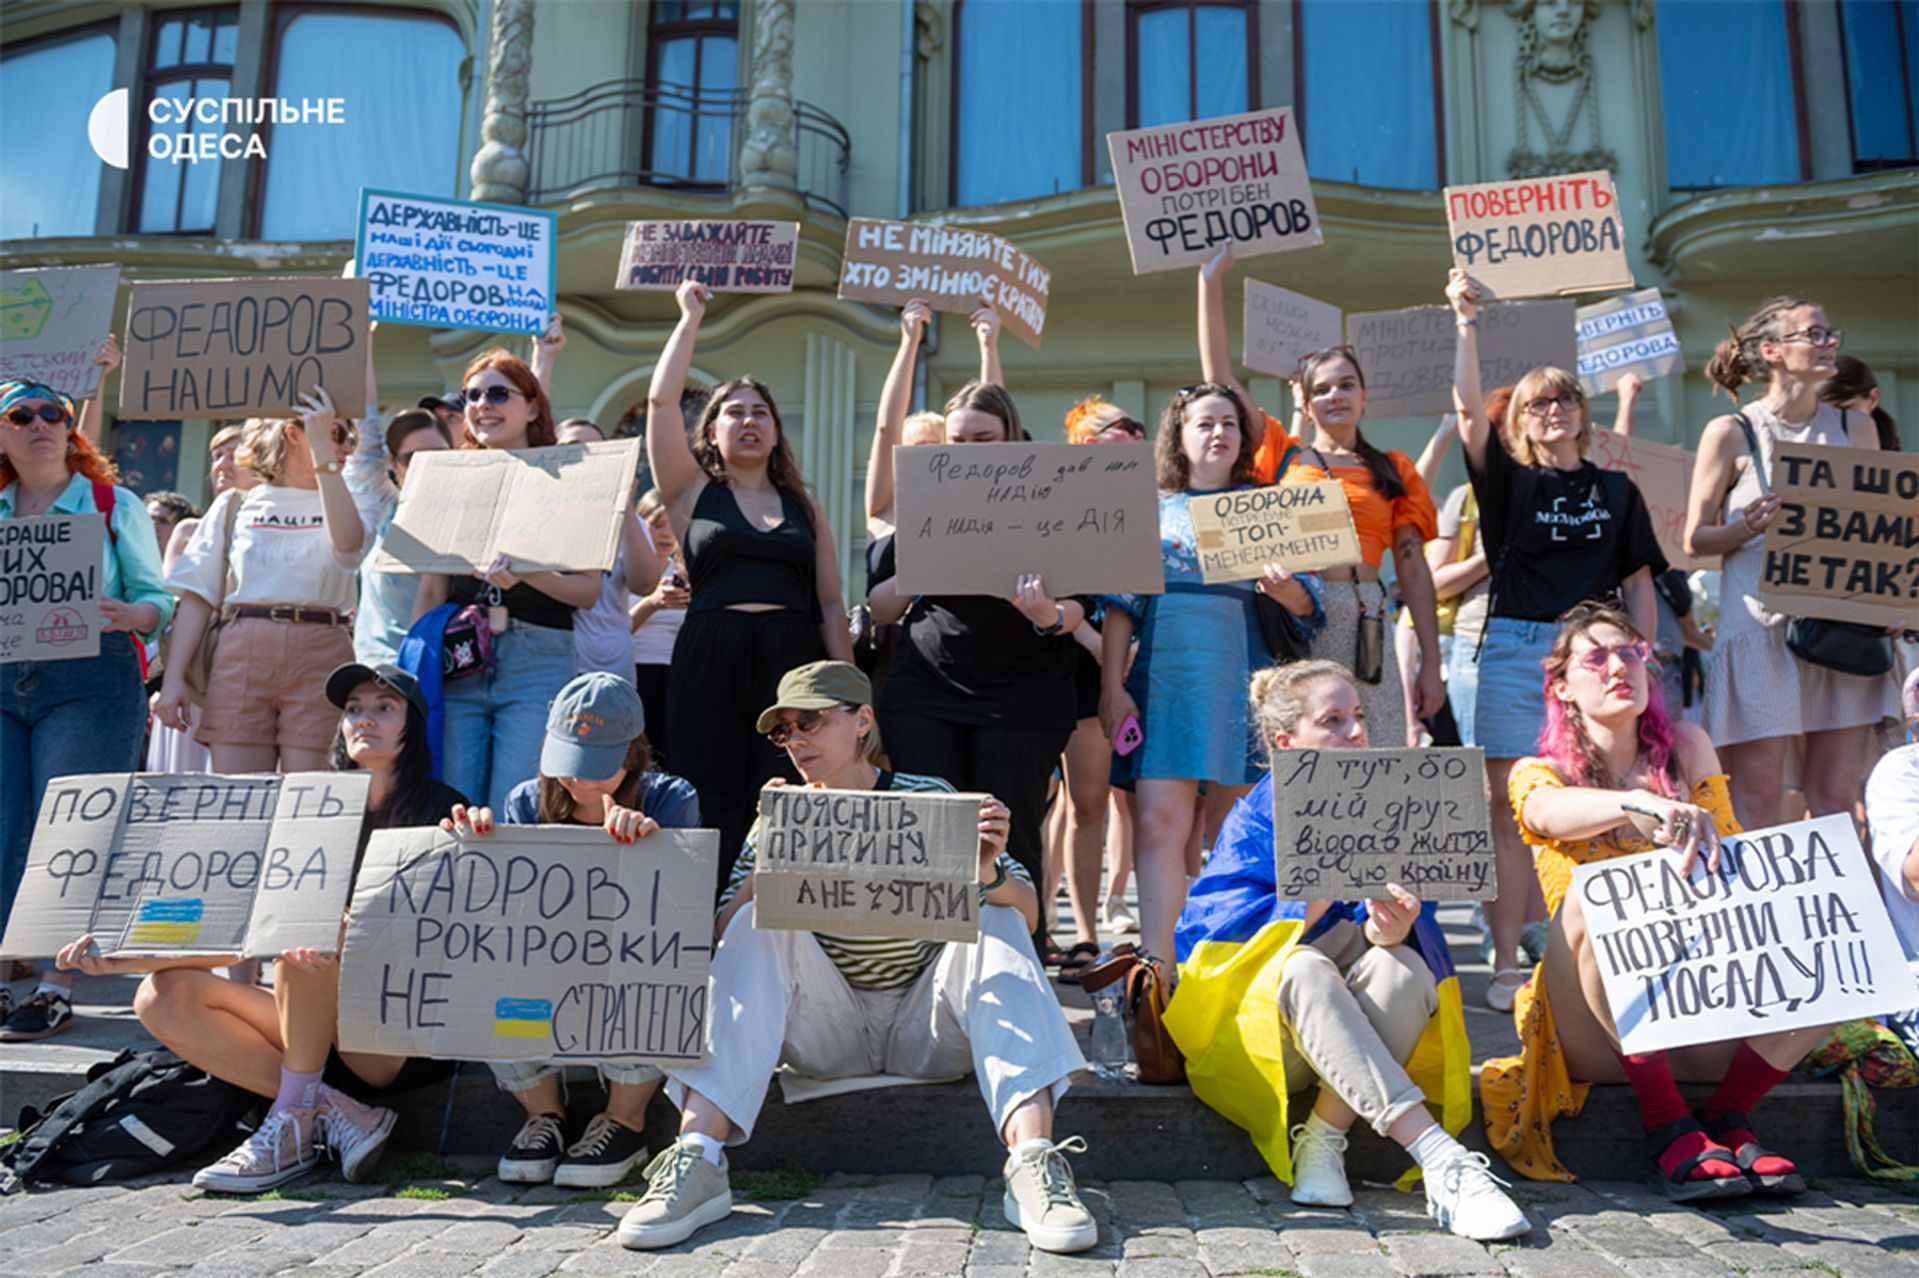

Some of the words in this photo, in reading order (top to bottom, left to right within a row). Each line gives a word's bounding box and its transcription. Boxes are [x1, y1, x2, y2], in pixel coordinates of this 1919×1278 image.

[1127, 114, 1287, 163] МІНІСТЕРСТВУ
[1140, 150, 1279, 194] ОБОРОНИ
[1161, 182, 1271, 214] ПОТРІБЕН
[1450, 179, 1612, 221] ПОВЕРНІТЬ
[634, 223, 658, 241] НЕ
[1145, 199, 1311, 255] ФЕДОРОВ
[1456, 216, 1620, 265] ФЕДОРОВА
[843, 261, 891, 289] ХТО
[894, 264, 998, 302] ЗМІНЮЄ
[858, 224, 904, 250] НЕ
[908, 228, 1015, 272] МІНЯЙТЕ
[1017, 253, 1051, 296] ТИХ
[368, 271, 507, 307] ФЕДОРОВ
[130, 294, 355, 361] ФЕДОРОВ
[453, 308, 542, 333] ОБОРОНИ
[143, 365, 251, 412] НАШ
[1780, 455, 1836, 489] ТА
[1853, 464, 1919, 499] ШО
[1215, 487, 1326, 518] ОБОРОНА
[1777, 503, 1807, 536] З
[1764, 550, 1811, 586] НЕ
[1284, 750, 1320, 787] Я
[1418, 754, 1466, 779] бо
[49, 778, 345, 825] ПОВЕРНІТЬ
[769, 792, 918, 833] ПОЯСНІТЬ
[1295, 792, 1366, 820] мій
[1373, 796, 1462, 832] друг
[1295, 824, 1400, 872] віддав
[47, 846, 327, 899] ФЕДОРОВА
[389, 850, 661, 926] КАДРОВІ
[1284, 865, 1320, 896] за
[1401, 860, 1489, 892] країну
[1584, 831, 1846, 921] ФЕДОРОВА
[797, 879, 817, 904] А
[821, 879, 856, 909] НЕ
[866, 879, 971, 922] ЧУТКИ
[1597, 902, 1782, 976] ПОВЕРНИ
[1796, 892, 1863, 941] НА
[380, 964, 452, 1030] НЕ
[551, 983, 707, 1053] СТРАТЕГІЯ
